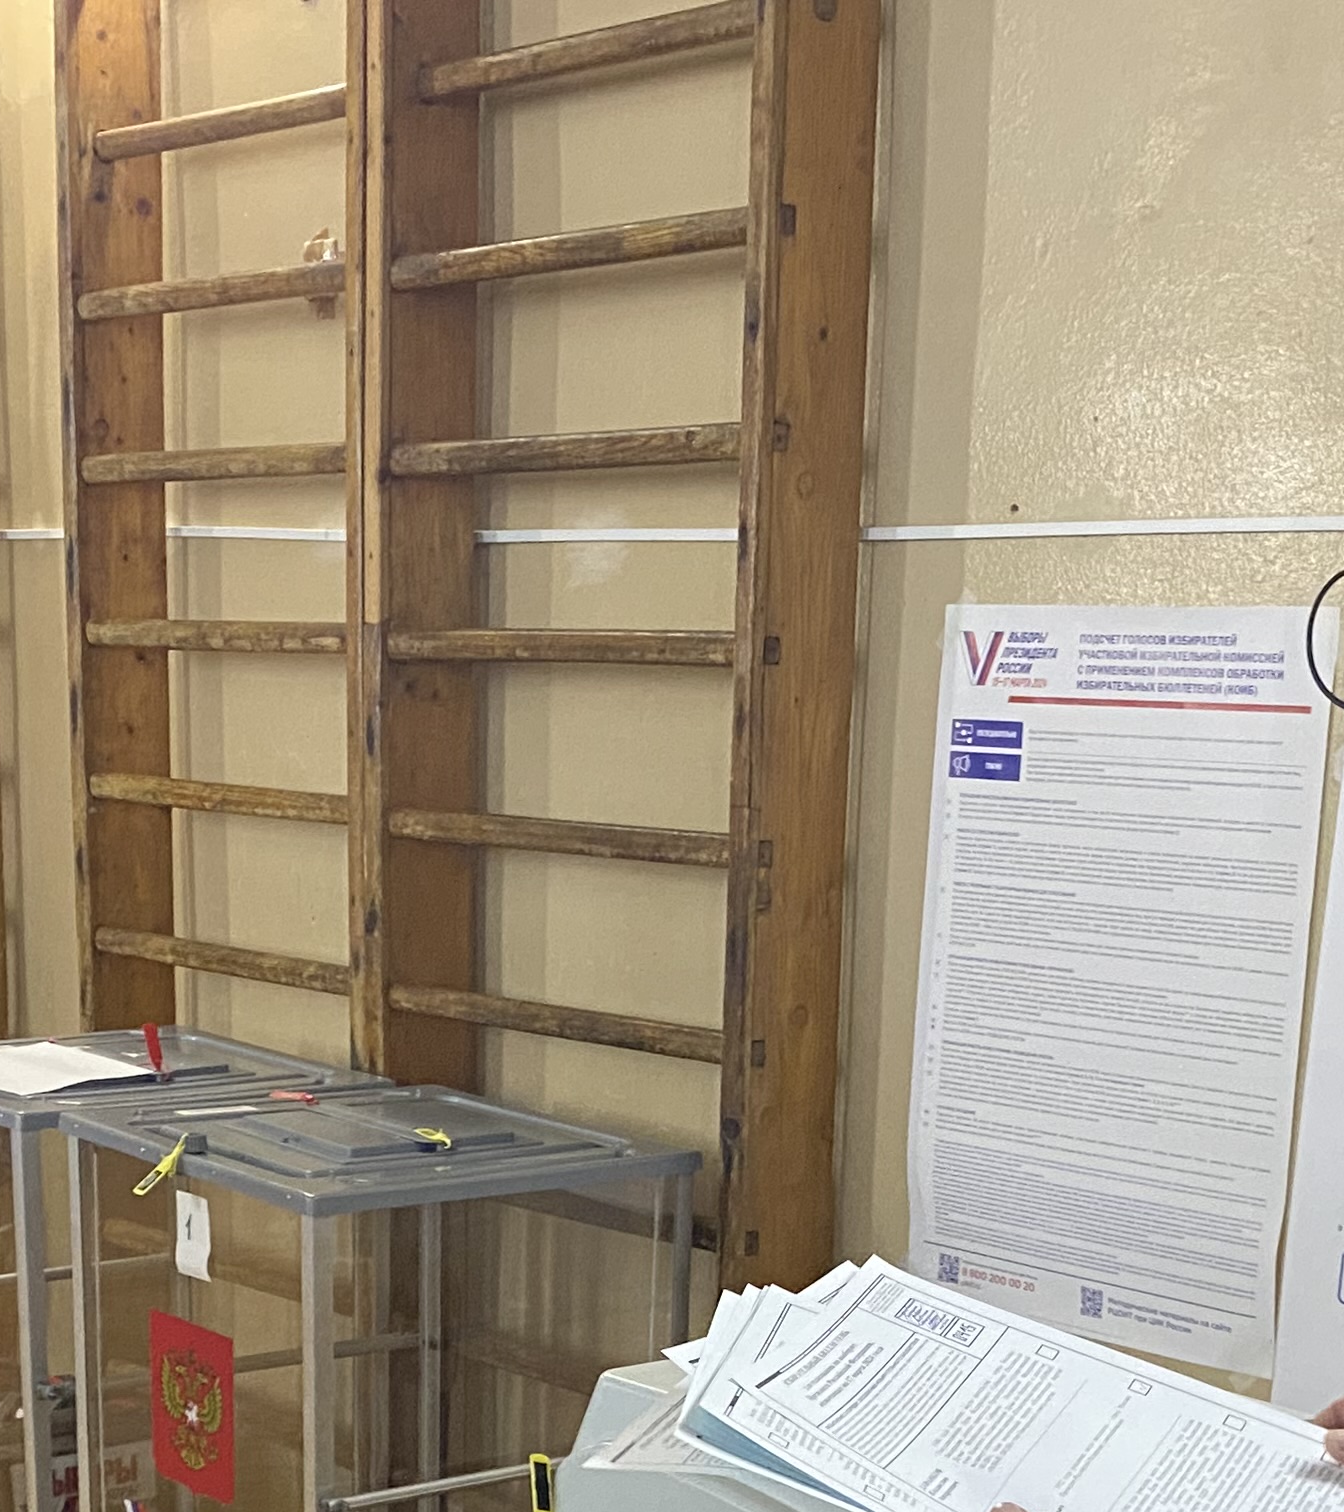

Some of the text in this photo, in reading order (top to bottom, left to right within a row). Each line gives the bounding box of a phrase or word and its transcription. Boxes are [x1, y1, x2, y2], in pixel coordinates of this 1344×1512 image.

[1122, 634, 1166, 645] ГОЛОСОВ
[1168, 634, 1237, 646] ИЗБИРАТЕЛЕЙ
[1000, 647, 1058, 659] ПРЕЗИДЕНТА
[1139, 649, 1221, 662] ИЗБИРАТЕЛЬНОЙ
[1223, 650, 1284, 663] КОМИССИЕЙ
[996, 662, 1032, 674] РОССИИ
[1077, 664, 1284, 679] С ПРИМЕНЕНИЕМ КОМПЛЕКСОВ ОБРАБОТКИ
[1076, 680, 1155, 692] ИЗБИРАТЕЛЬНЫХ
[1157, 682, 1221, 694] БЮЛЛЕТЕНЕЙ
[1023, 1281, 1036, 1292] 20
